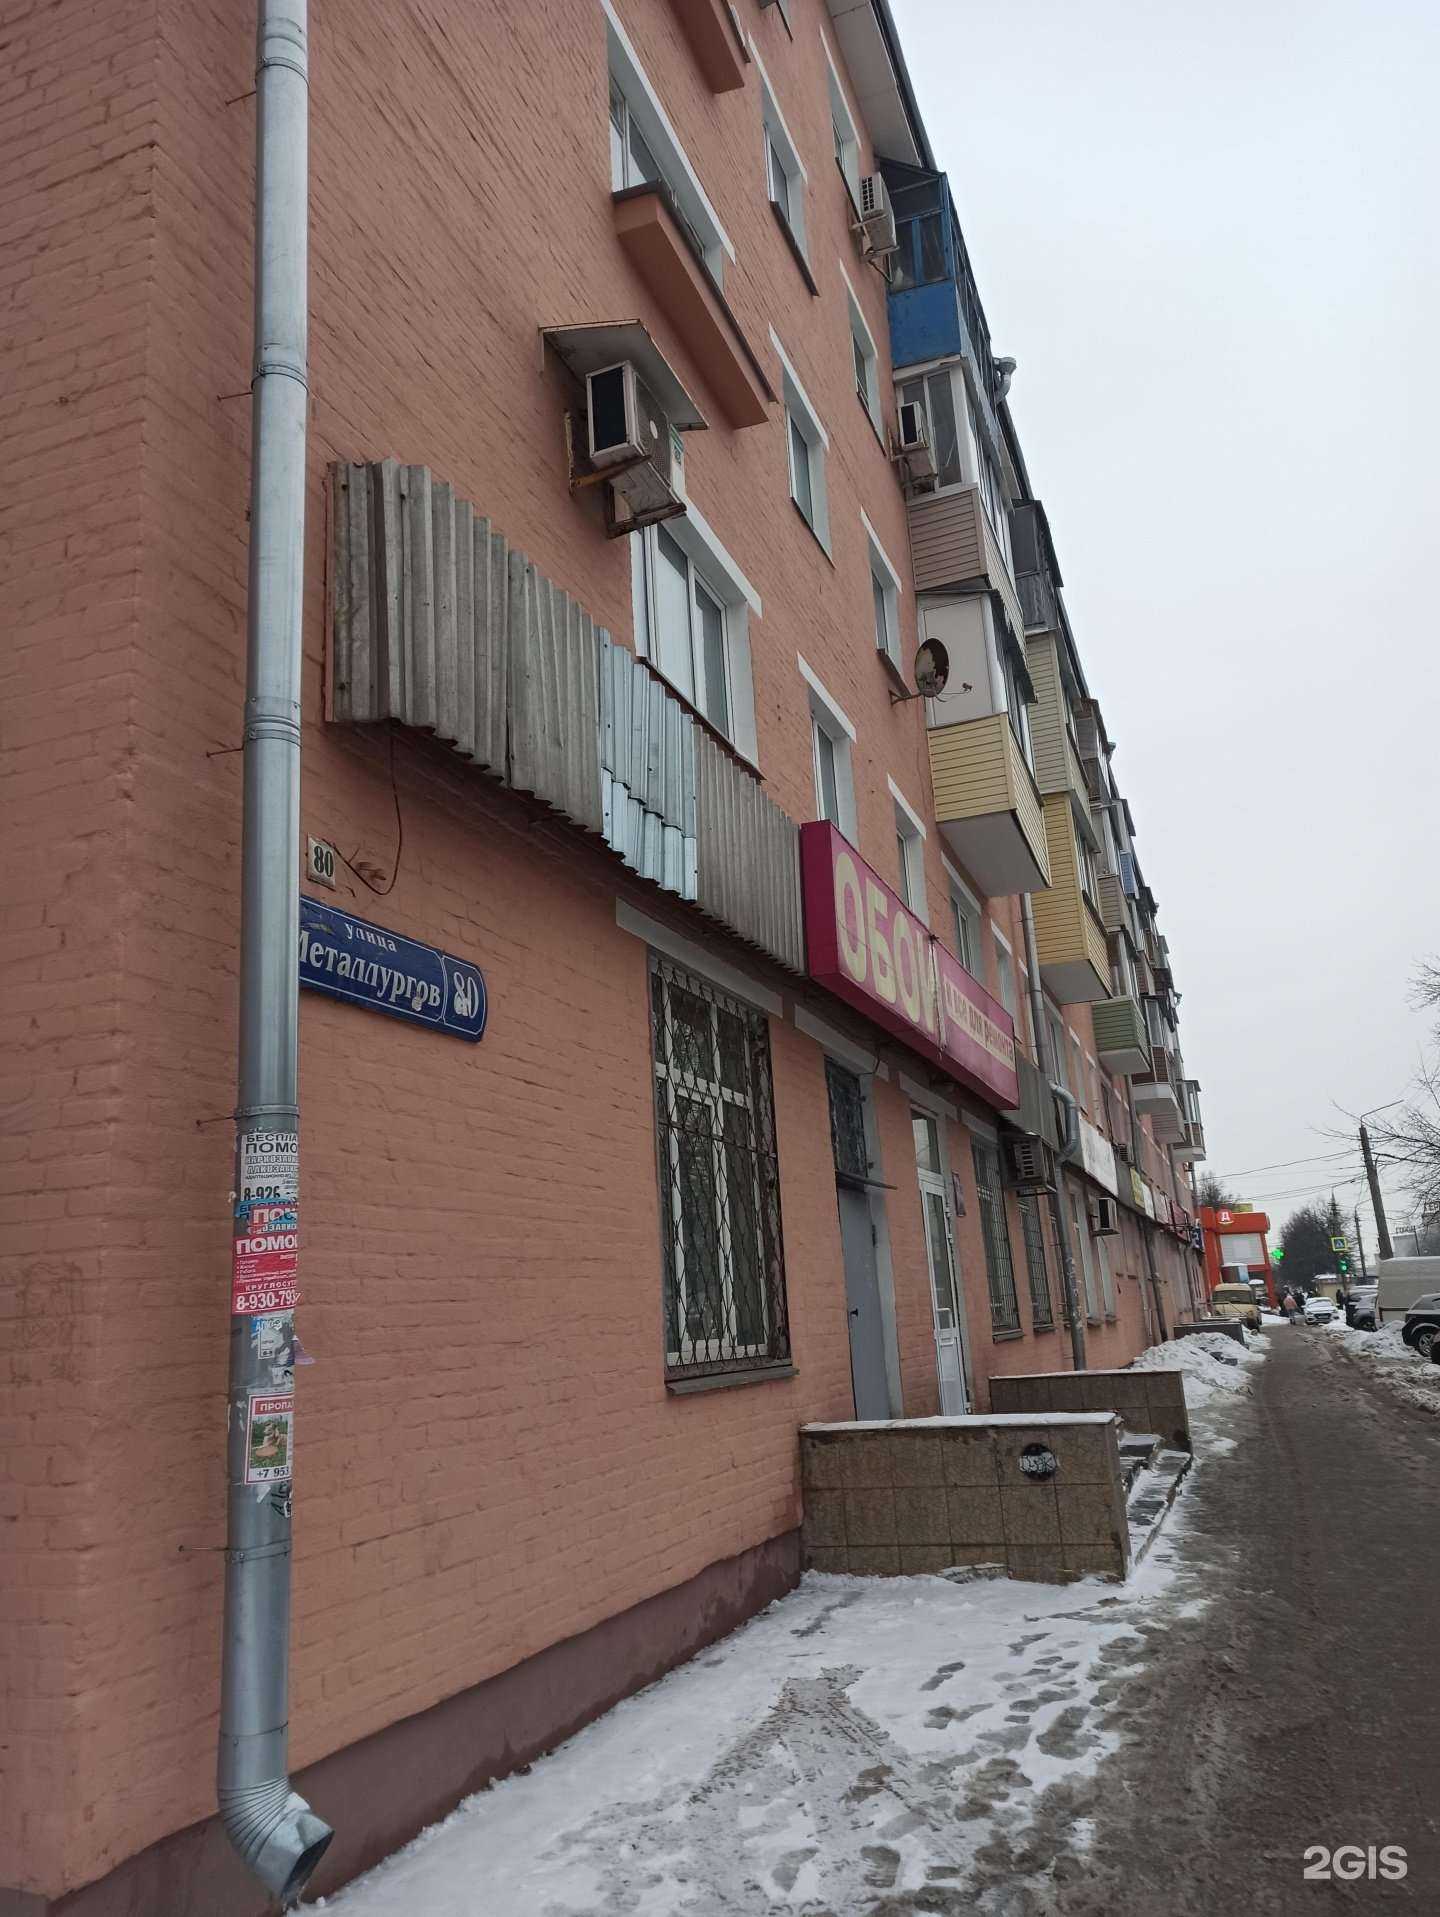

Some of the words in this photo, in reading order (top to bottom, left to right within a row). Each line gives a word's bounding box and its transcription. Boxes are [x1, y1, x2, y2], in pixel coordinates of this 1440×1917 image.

[313, 845, 335, 878] 80
[344, 923, 398, 953] улица
[453, 971, 480, 1019] 80
